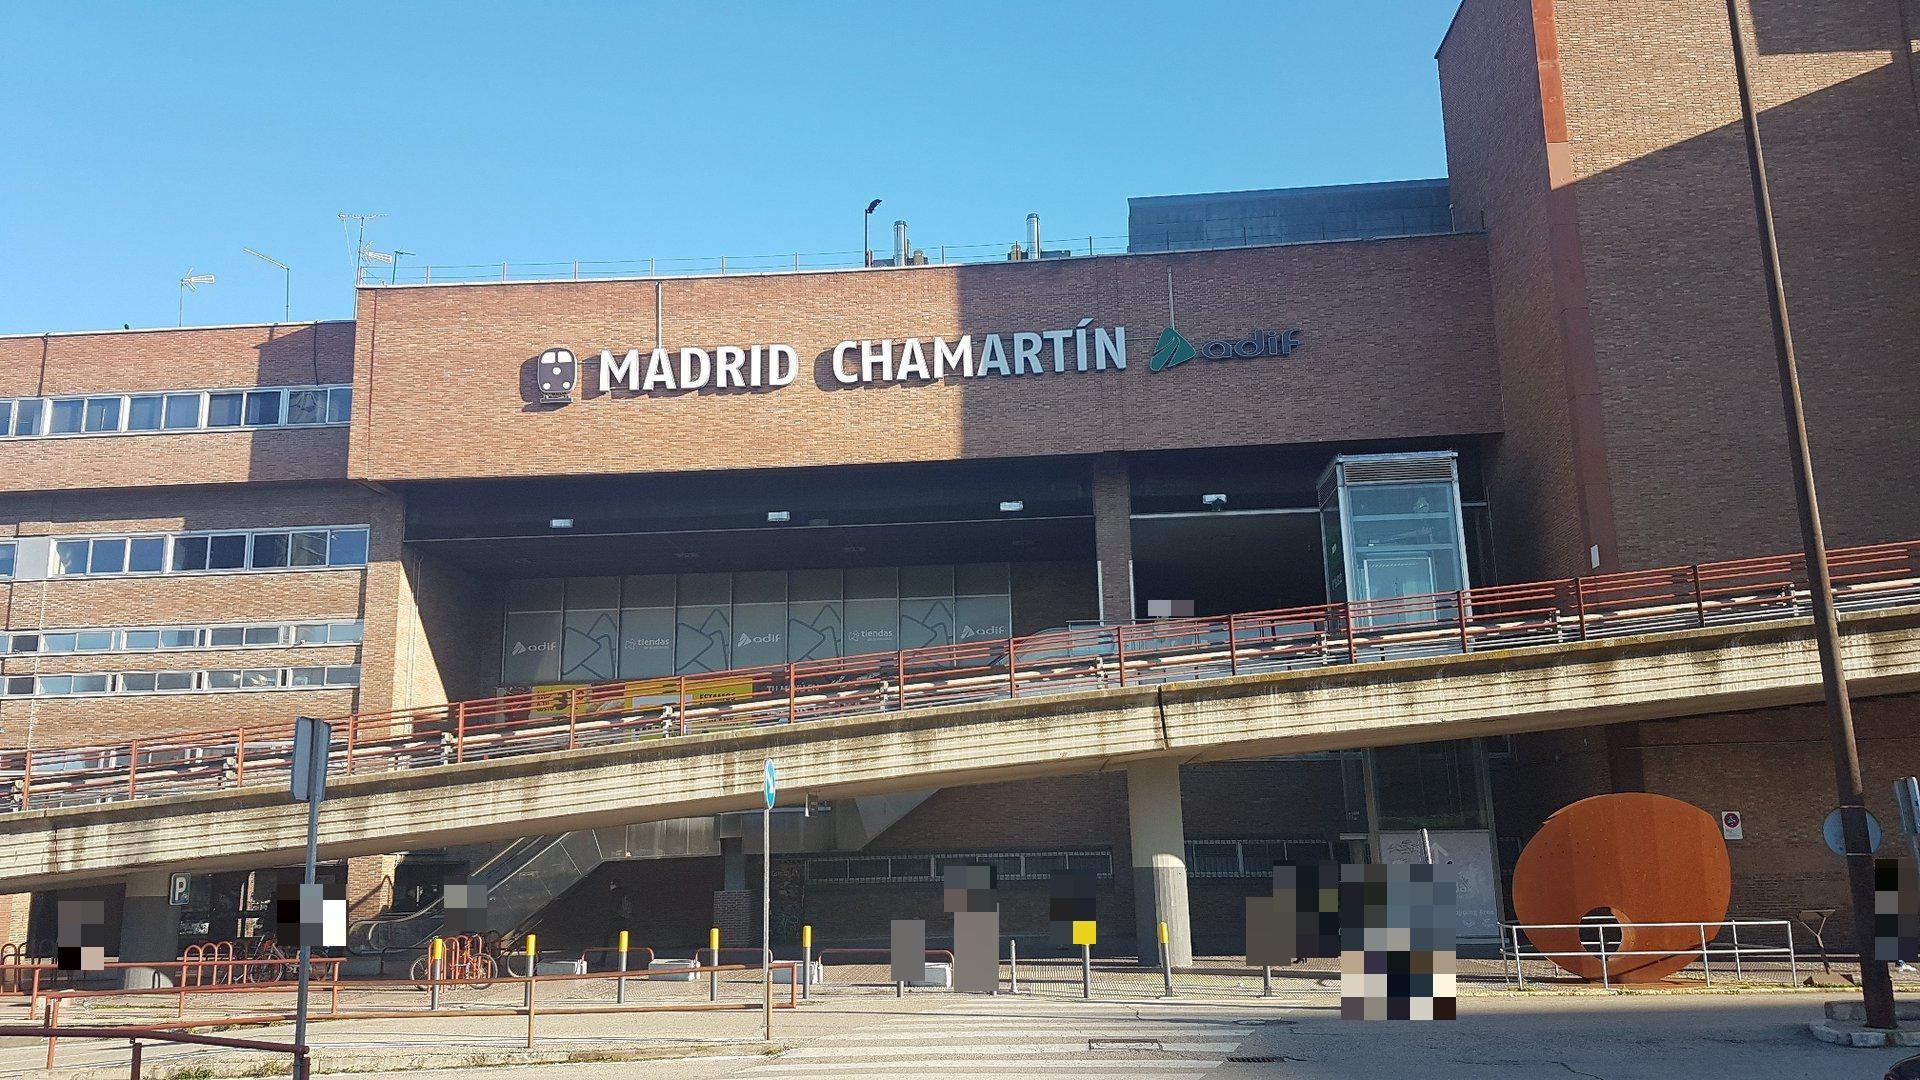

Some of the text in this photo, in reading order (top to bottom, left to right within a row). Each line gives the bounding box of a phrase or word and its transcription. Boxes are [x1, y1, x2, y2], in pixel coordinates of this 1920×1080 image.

[1203, 328, 1303, 360] adif
[598, 319, 1127, 392] MADRID CHAMARTÍN
[861, 629, 893, 637] tiendas
[976, 626, 1007, 635] adif
[638, 638, 670, 646] tiendas
[753, 632, 782, 643] adif
[528, 641, 557, 651] adif
[175, 876, 187, 901] P
